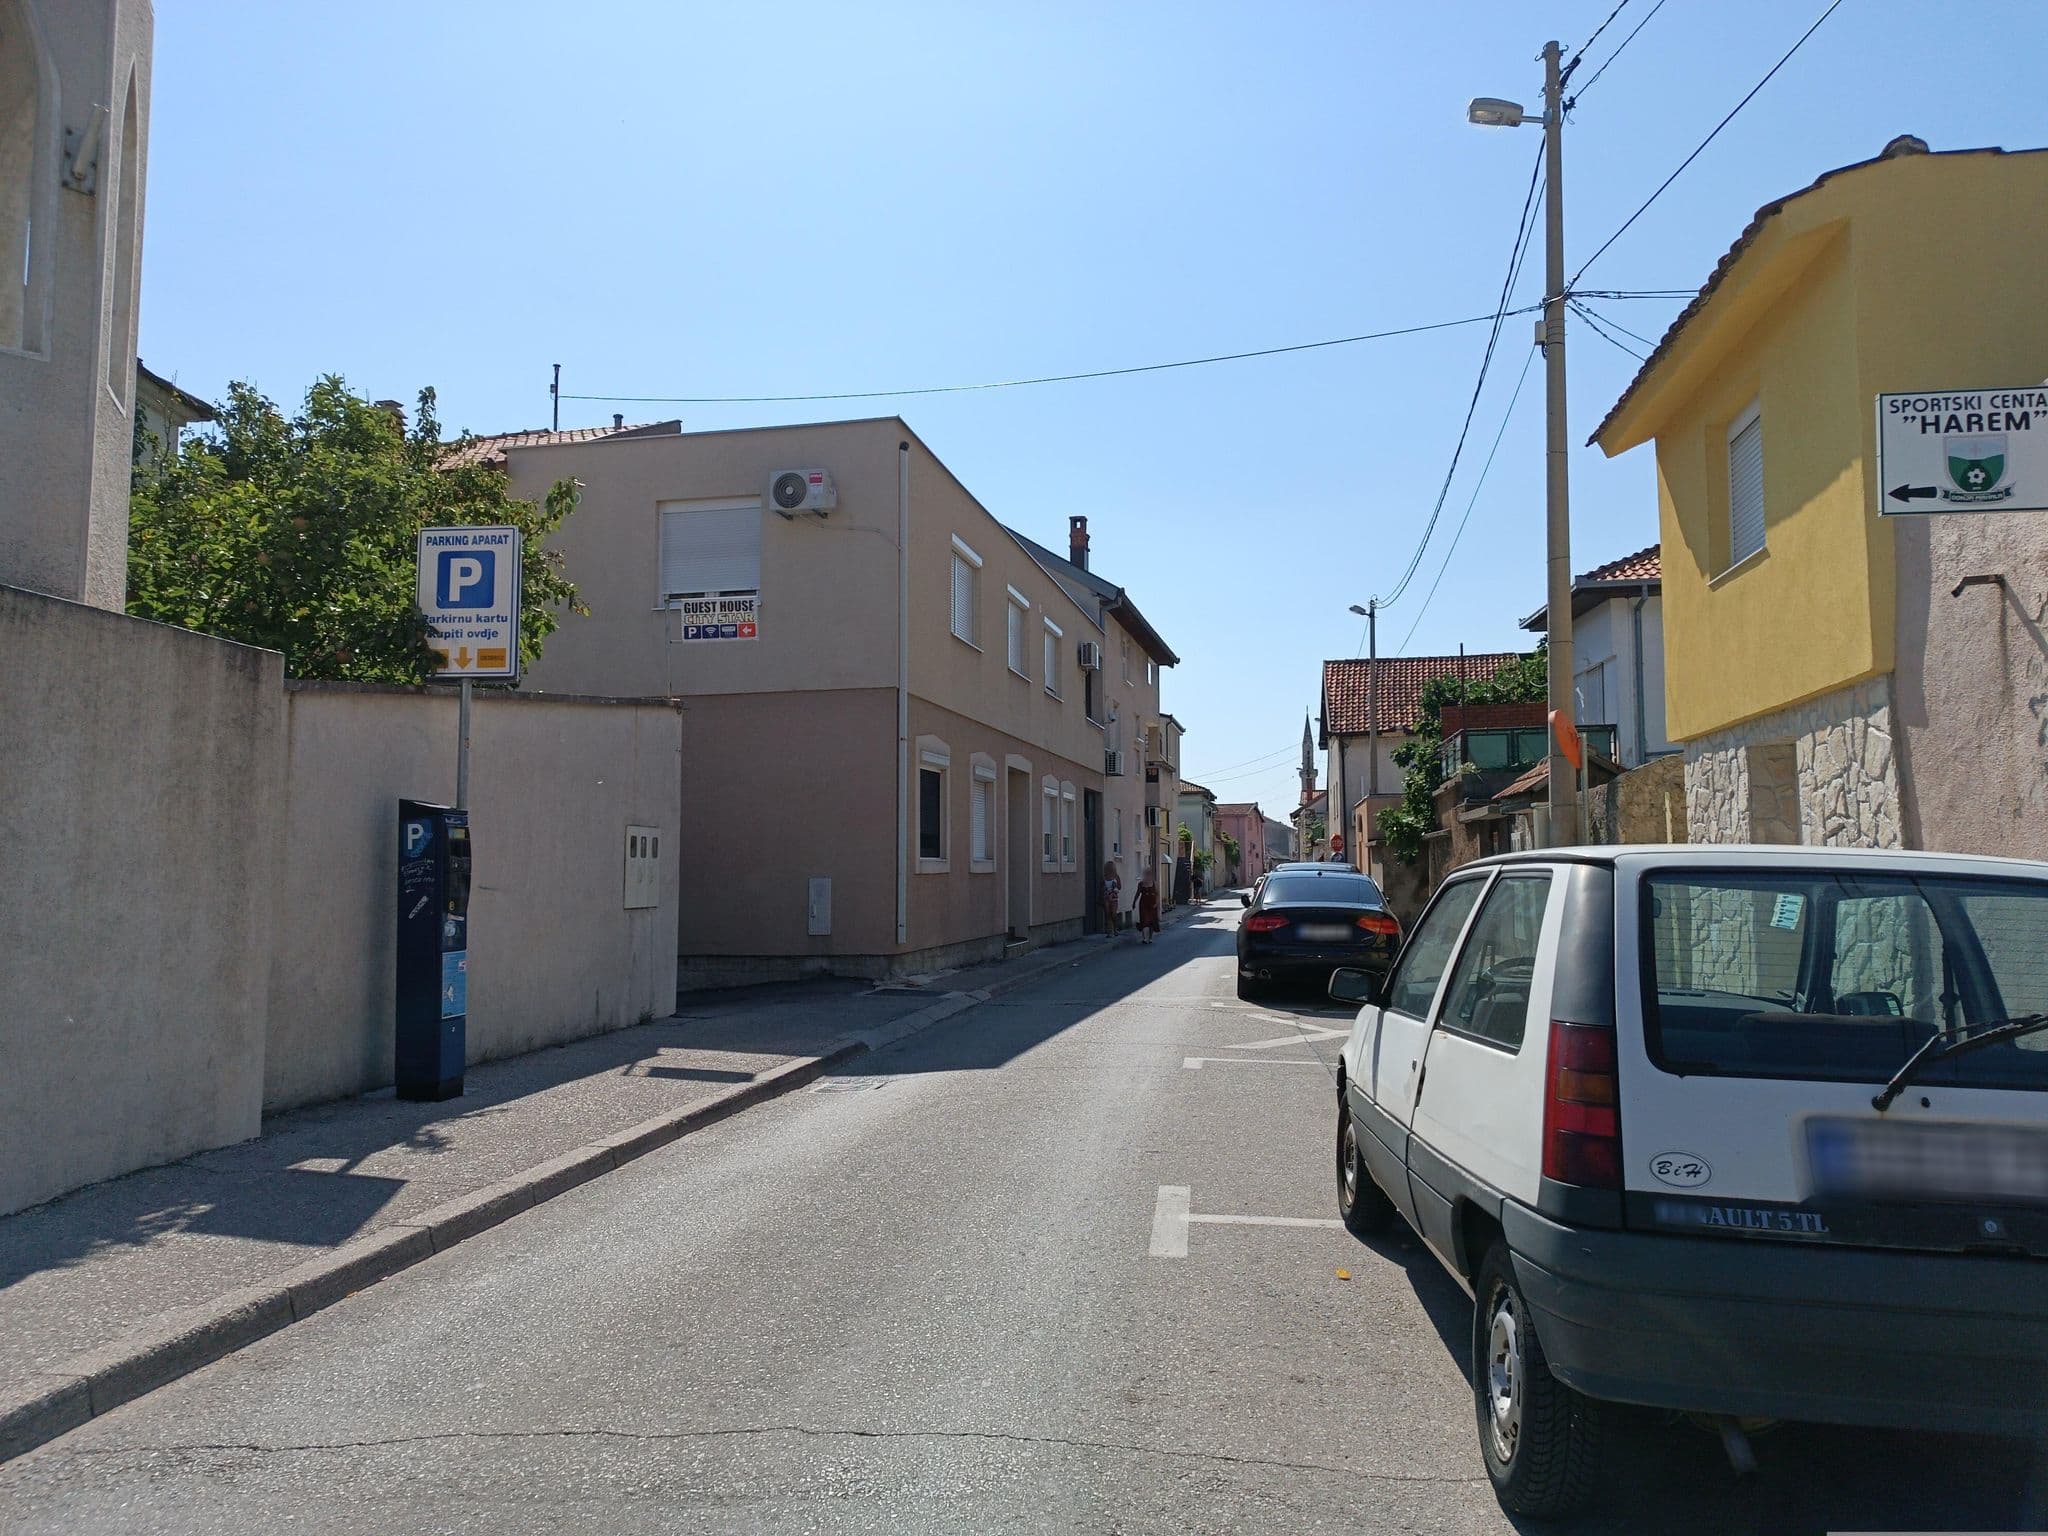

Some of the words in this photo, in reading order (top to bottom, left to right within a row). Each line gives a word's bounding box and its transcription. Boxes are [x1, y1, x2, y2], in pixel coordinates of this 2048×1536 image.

[1889, 396, 1982, 414] SPORTSKI
[1990, 393, 2048, 409] CENTA
[426, 536, 469, 546] PARKING
[471, 535, 509, 545] APARAT
[449, 557, 482, 602] P
[684, 601, 717, 613] GUEST
[719, 600, 754, 612] HOUSE
[475, 614, 508, 623] kartu
[683, 614, 715, 624] CITY
[717, 612, 754, 623] STAR
[467, 629, 499, 640] ovdje
[407, 823, 424, 850] P
[1655, 1160, 1703, 1178] BiH
[1779, 1212, 1793, 1230] 5
[1795, 1212, 1830, 1233] TL
